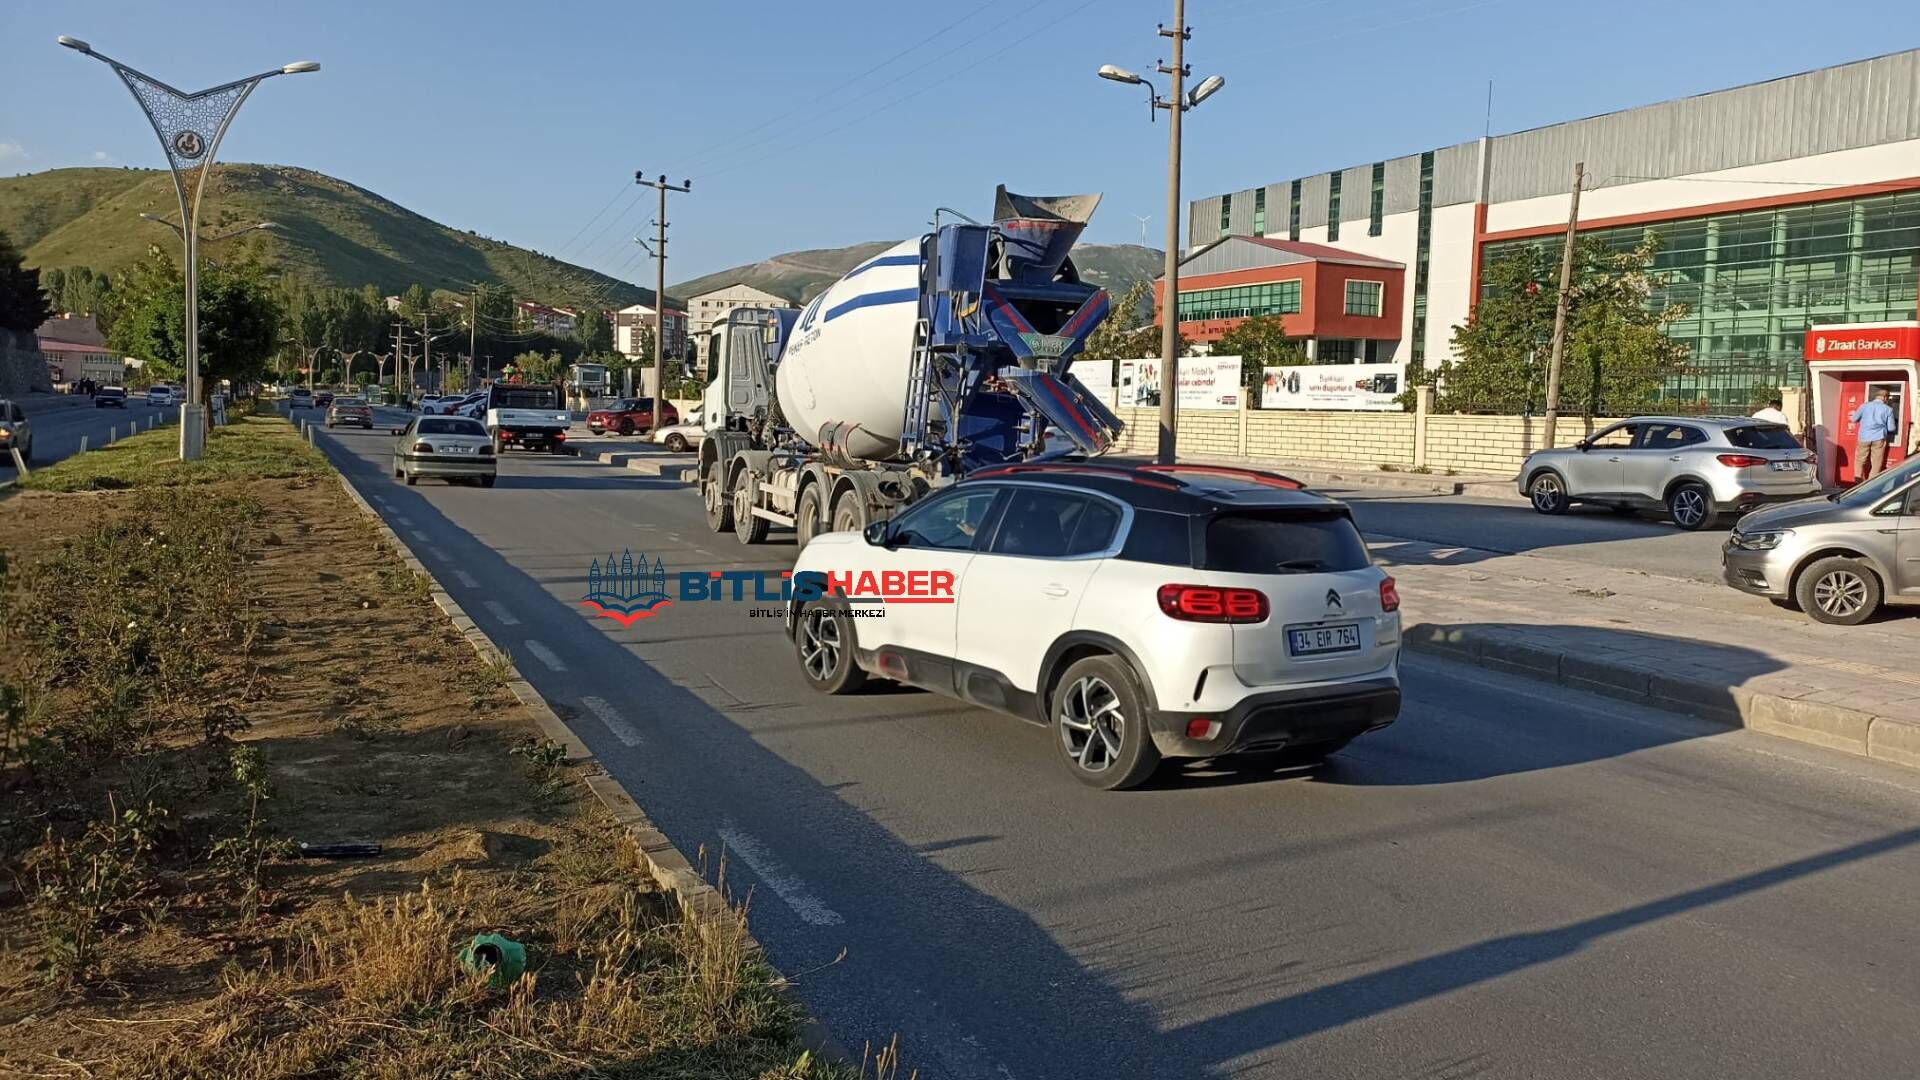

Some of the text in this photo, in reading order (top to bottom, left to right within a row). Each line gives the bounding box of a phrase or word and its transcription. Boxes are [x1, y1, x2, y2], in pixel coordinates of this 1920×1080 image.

[1827, 339, 1897, 351] Ziraat Bankası
[1298, 629, 1355, 648] 34 EIR 764
